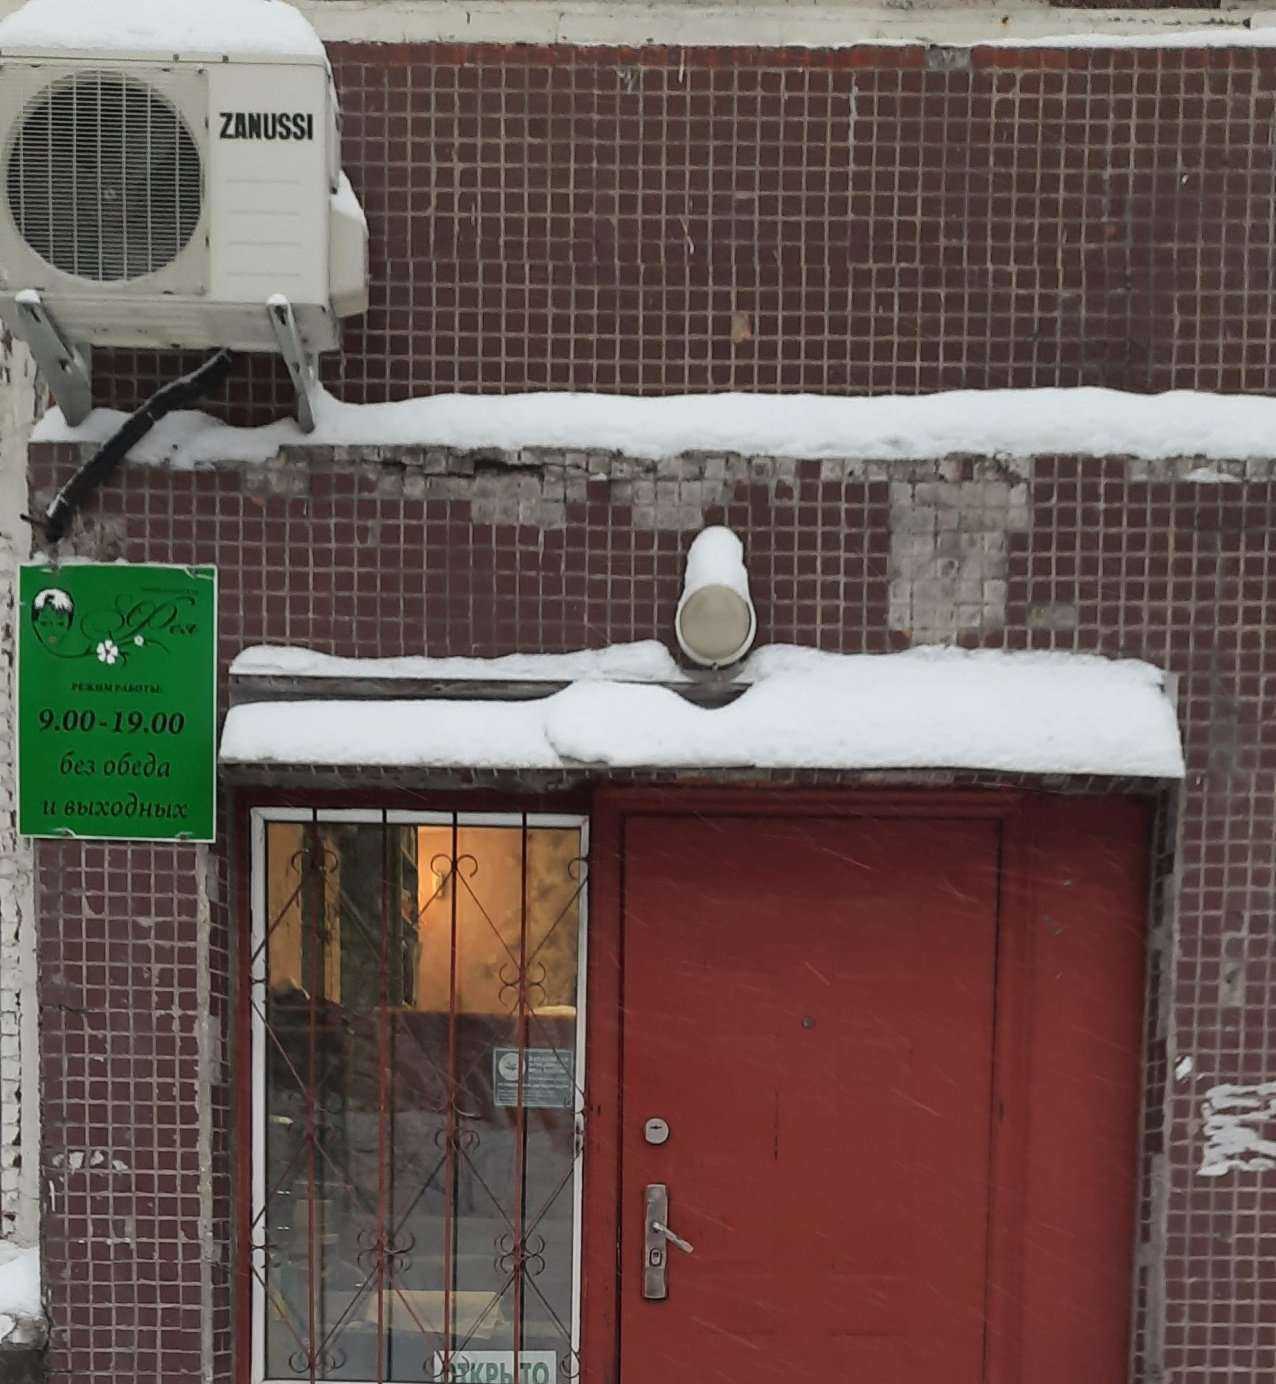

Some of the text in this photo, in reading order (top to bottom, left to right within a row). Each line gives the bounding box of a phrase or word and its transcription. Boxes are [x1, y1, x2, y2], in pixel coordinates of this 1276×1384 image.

[219, 112, 313, 140] ZANUSSI
[60, 750, 170, 778] без обеда
[43, 792, 189, 819] и выходных
